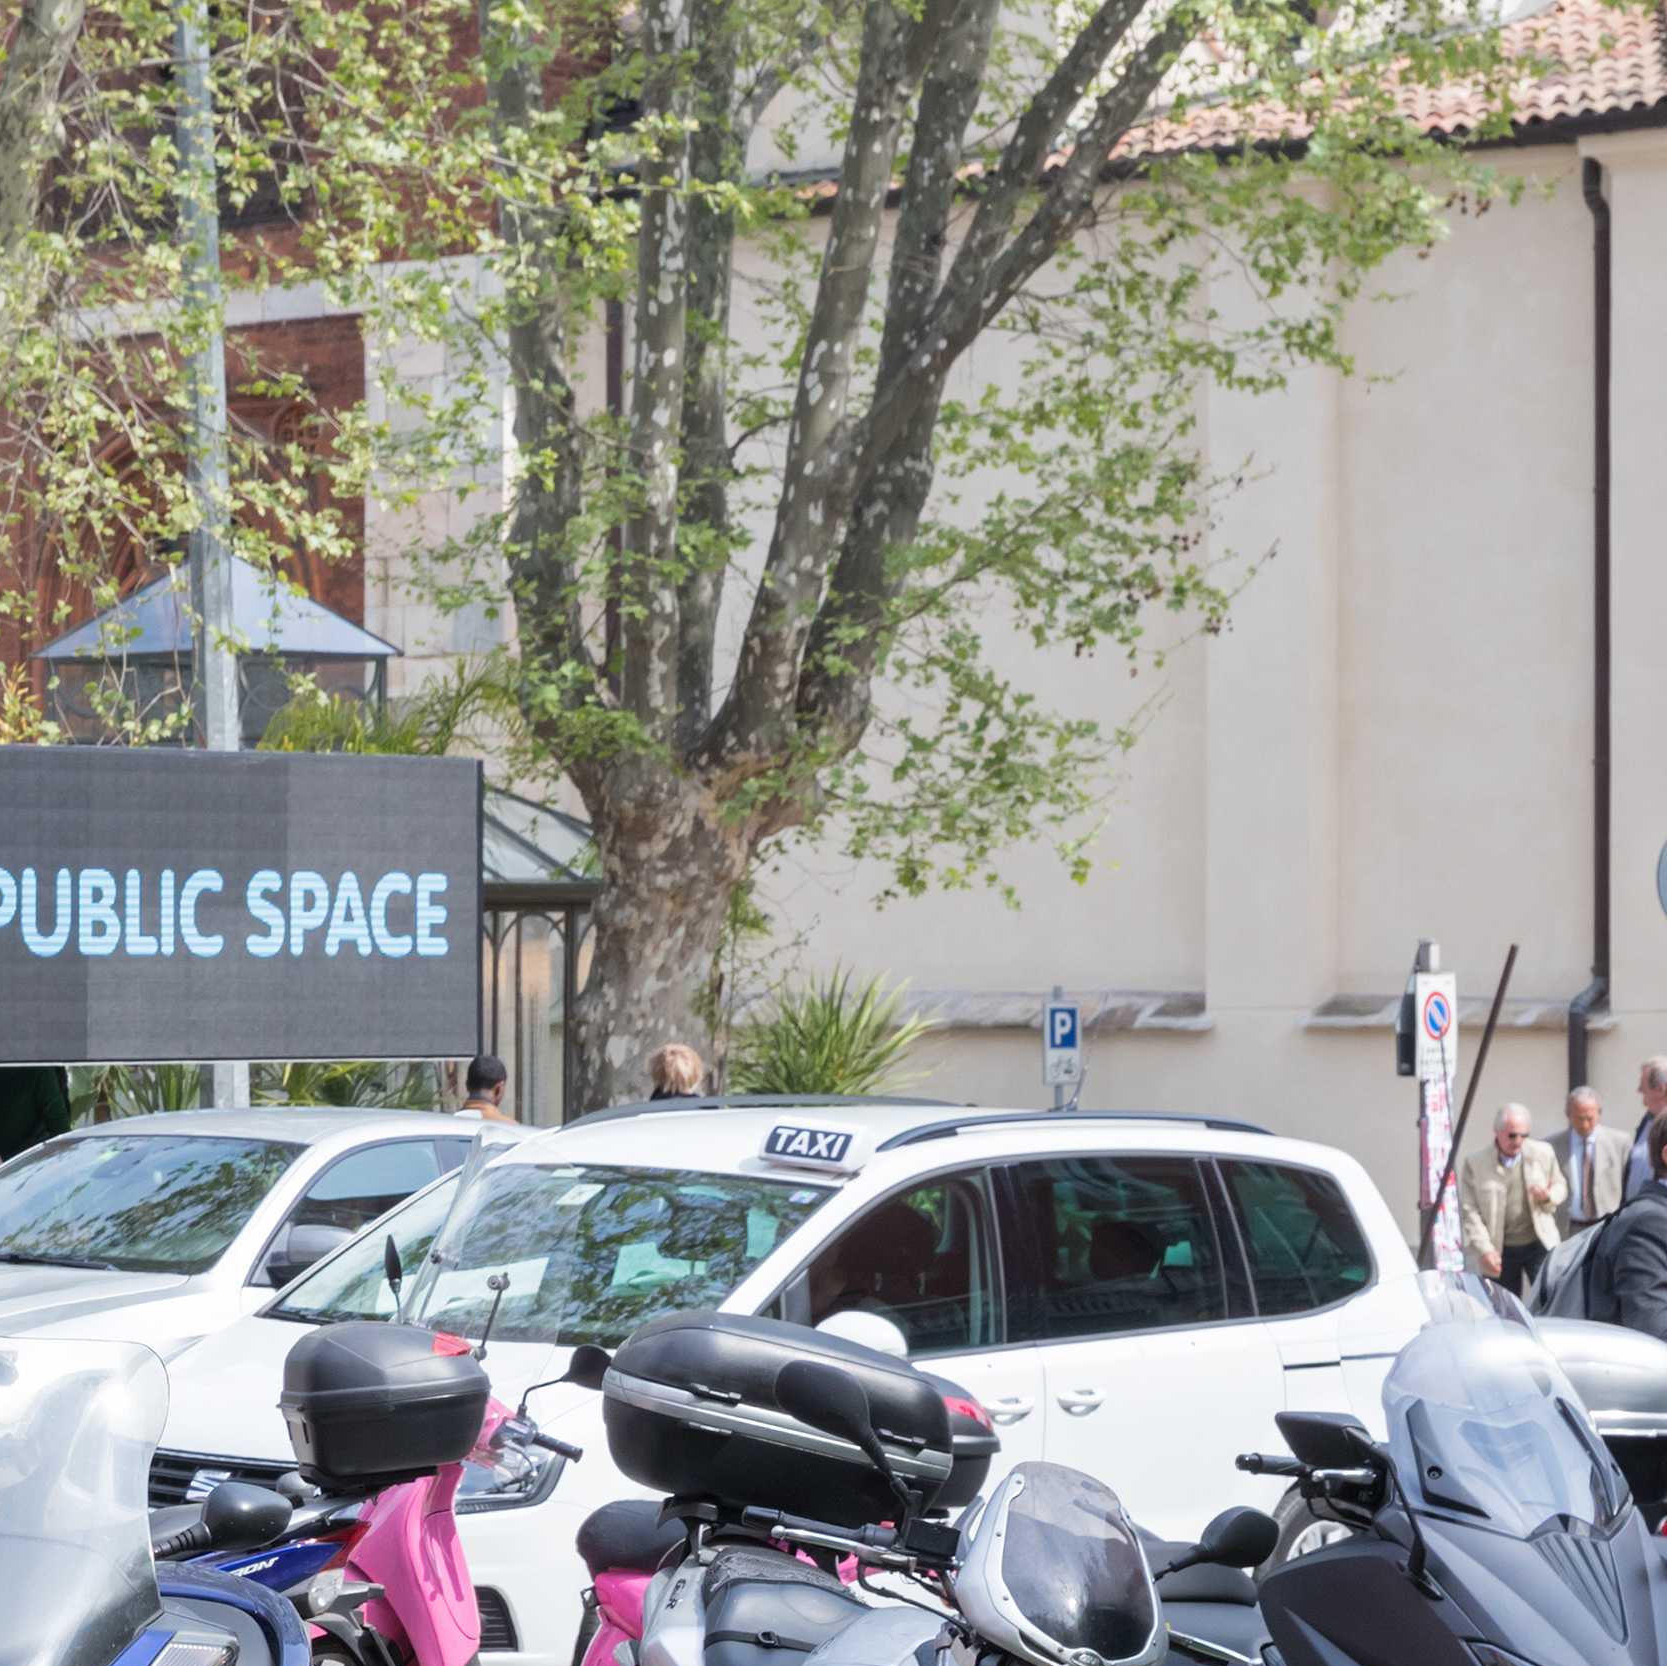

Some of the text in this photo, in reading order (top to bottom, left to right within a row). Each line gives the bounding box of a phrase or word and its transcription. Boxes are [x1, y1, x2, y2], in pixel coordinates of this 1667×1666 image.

[246, 870, 450, 957] SPACE
[1055, 1011, 1072, 1046] P
[775, 1127, 847, 1159] TAXI
